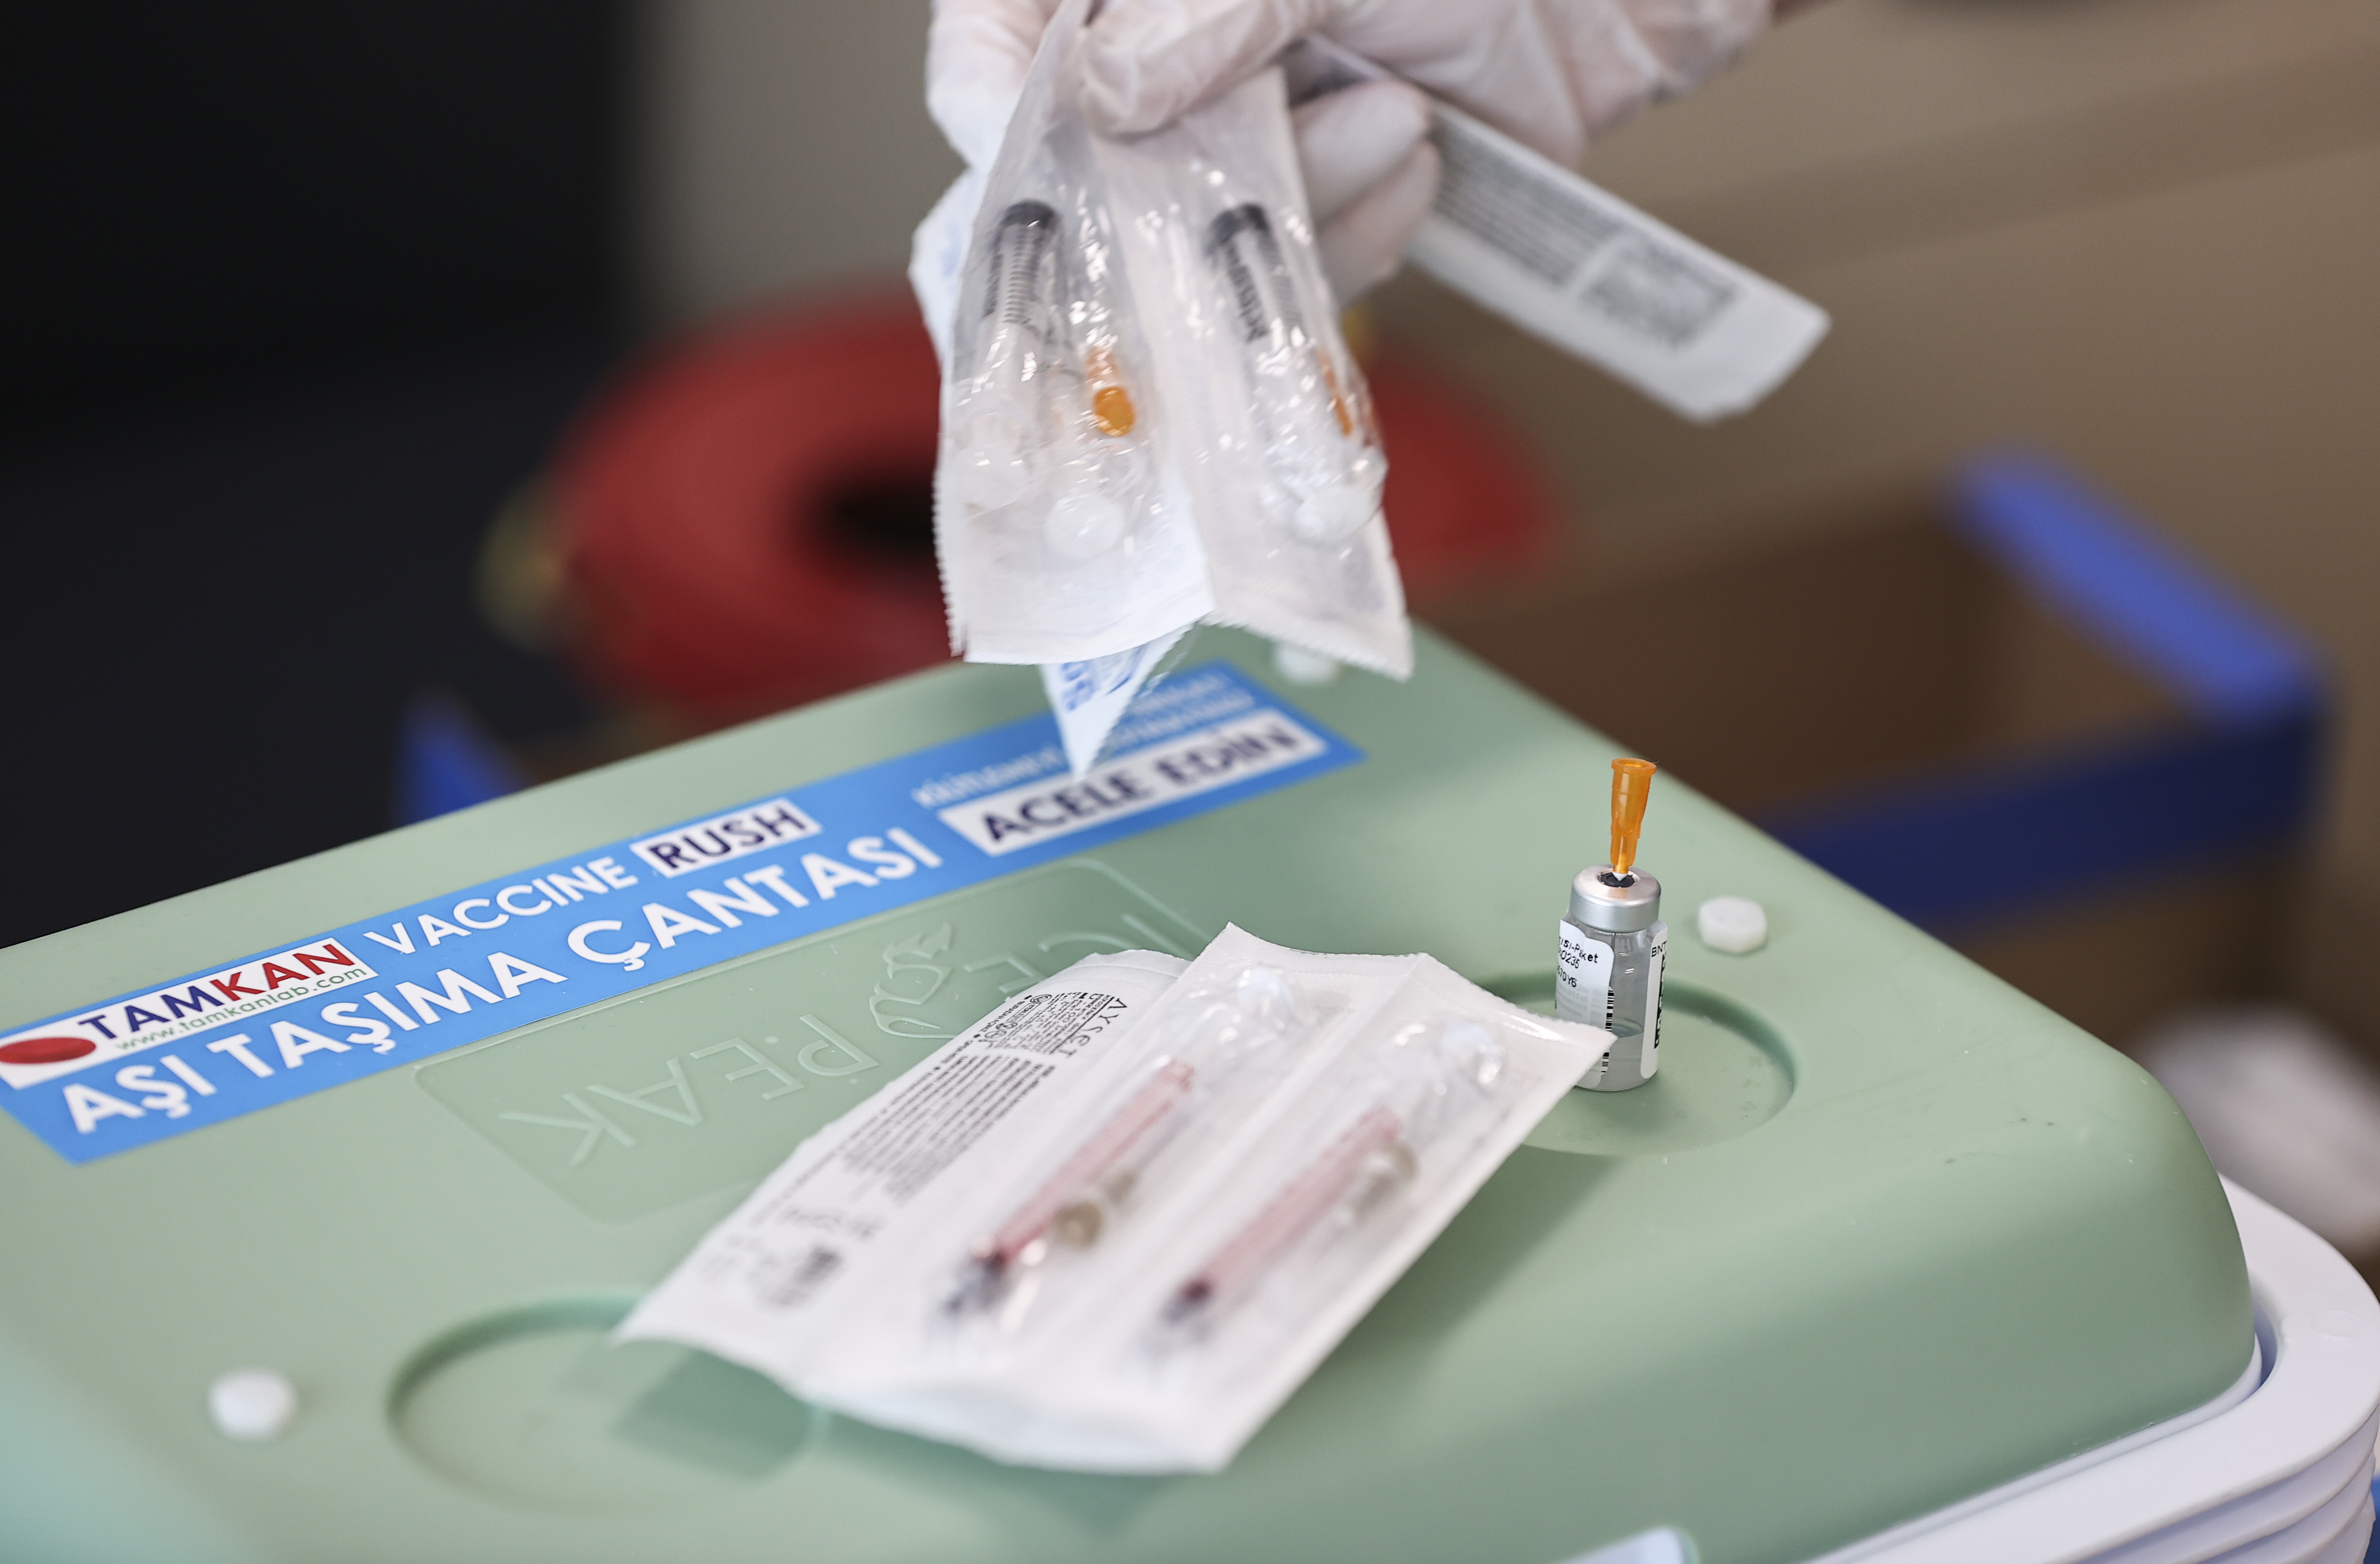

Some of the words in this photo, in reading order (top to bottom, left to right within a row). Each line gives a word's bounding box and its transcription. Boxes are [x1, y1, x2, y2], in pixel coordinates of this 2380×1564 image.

[981, 770, 1152, 842] ACELE
[363, 856, 638, 954] VACCINE
[647, 807, 807, 869] RUSH
[63, 1054, 216, 1134] AŞI
[207, 952, 568, 1078] TAŞIMA
[567, 827, 943, 972] ÇANTASI
[79, 943, 355, 1039] TAMKAN
[116, 966, 367, 1051] www.tamkanlab.com
[499, 1014, 881, 1168] PEAK
